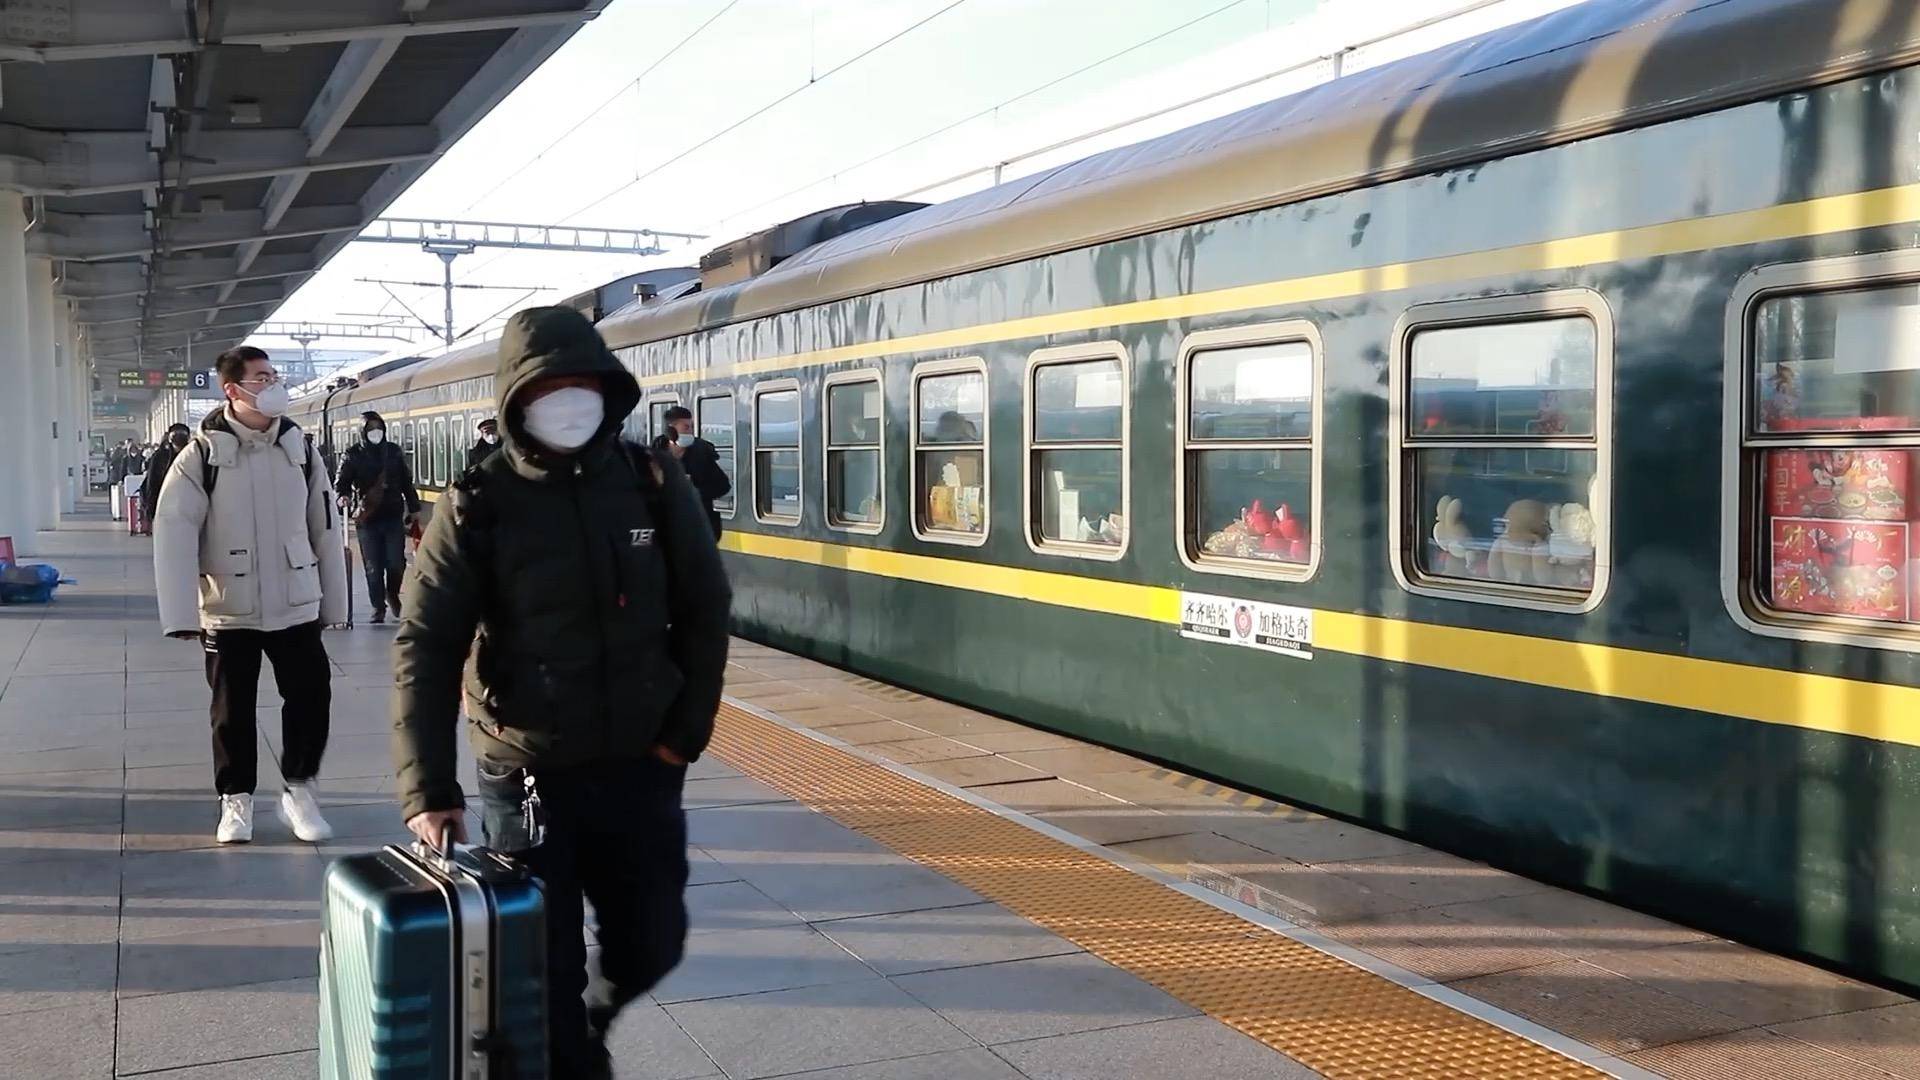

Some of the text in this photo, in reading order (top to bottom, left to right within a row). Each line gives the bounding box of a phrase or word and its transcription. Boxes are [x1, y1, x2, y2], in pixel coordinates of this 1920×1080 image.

[194, 373, 205, 387] 6
[1185, 600, 1228, 626] 齐齐哈尔
[1259, 610, 1309, 641] 加格达奇
